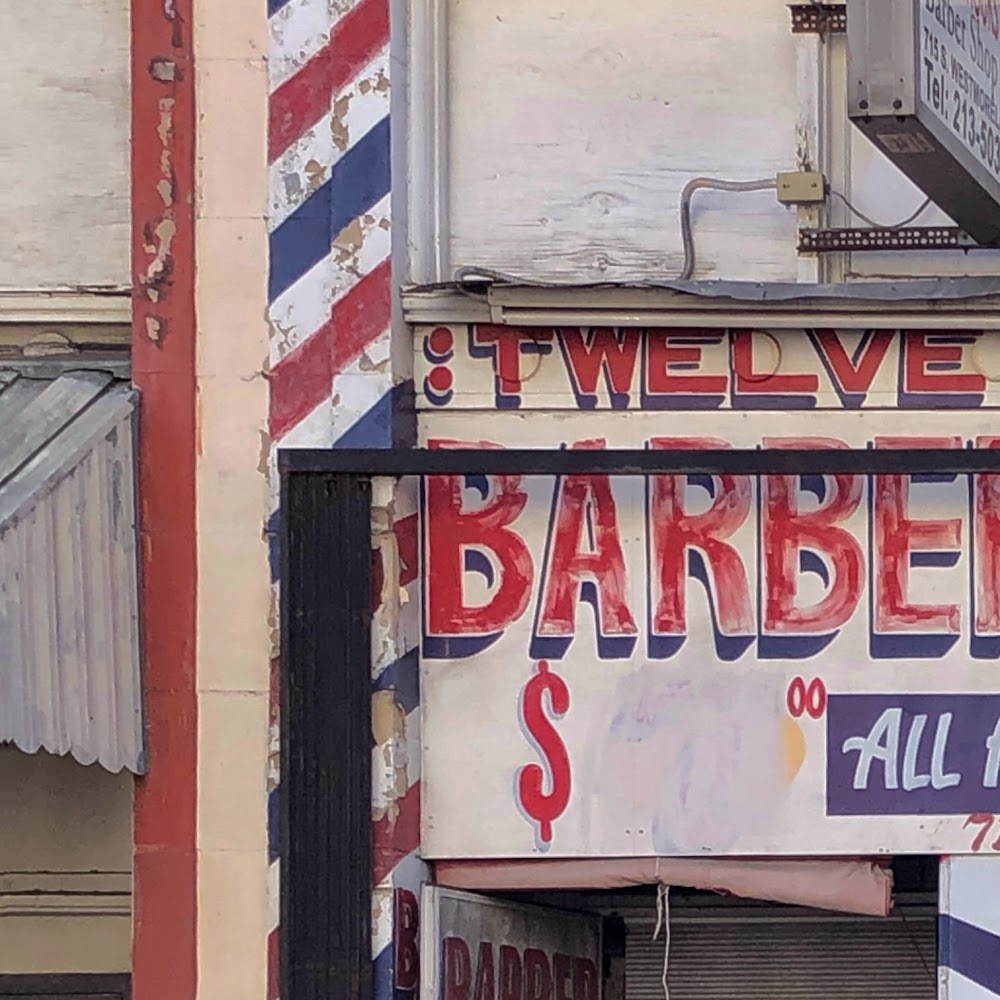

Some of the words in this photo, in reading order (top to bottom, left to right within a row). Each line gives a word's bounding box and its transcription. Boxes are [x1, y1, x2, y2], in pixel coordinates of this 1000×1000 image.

[923, 26, 939, 62] 715
[969, 14, 998, 104] Shop
[924, 56, 949, 120] Tel:
[468, 325, 986, 408] TWELVE
[787, 676, 827, 719] 00
[842, 707, 961, 790] ALL
